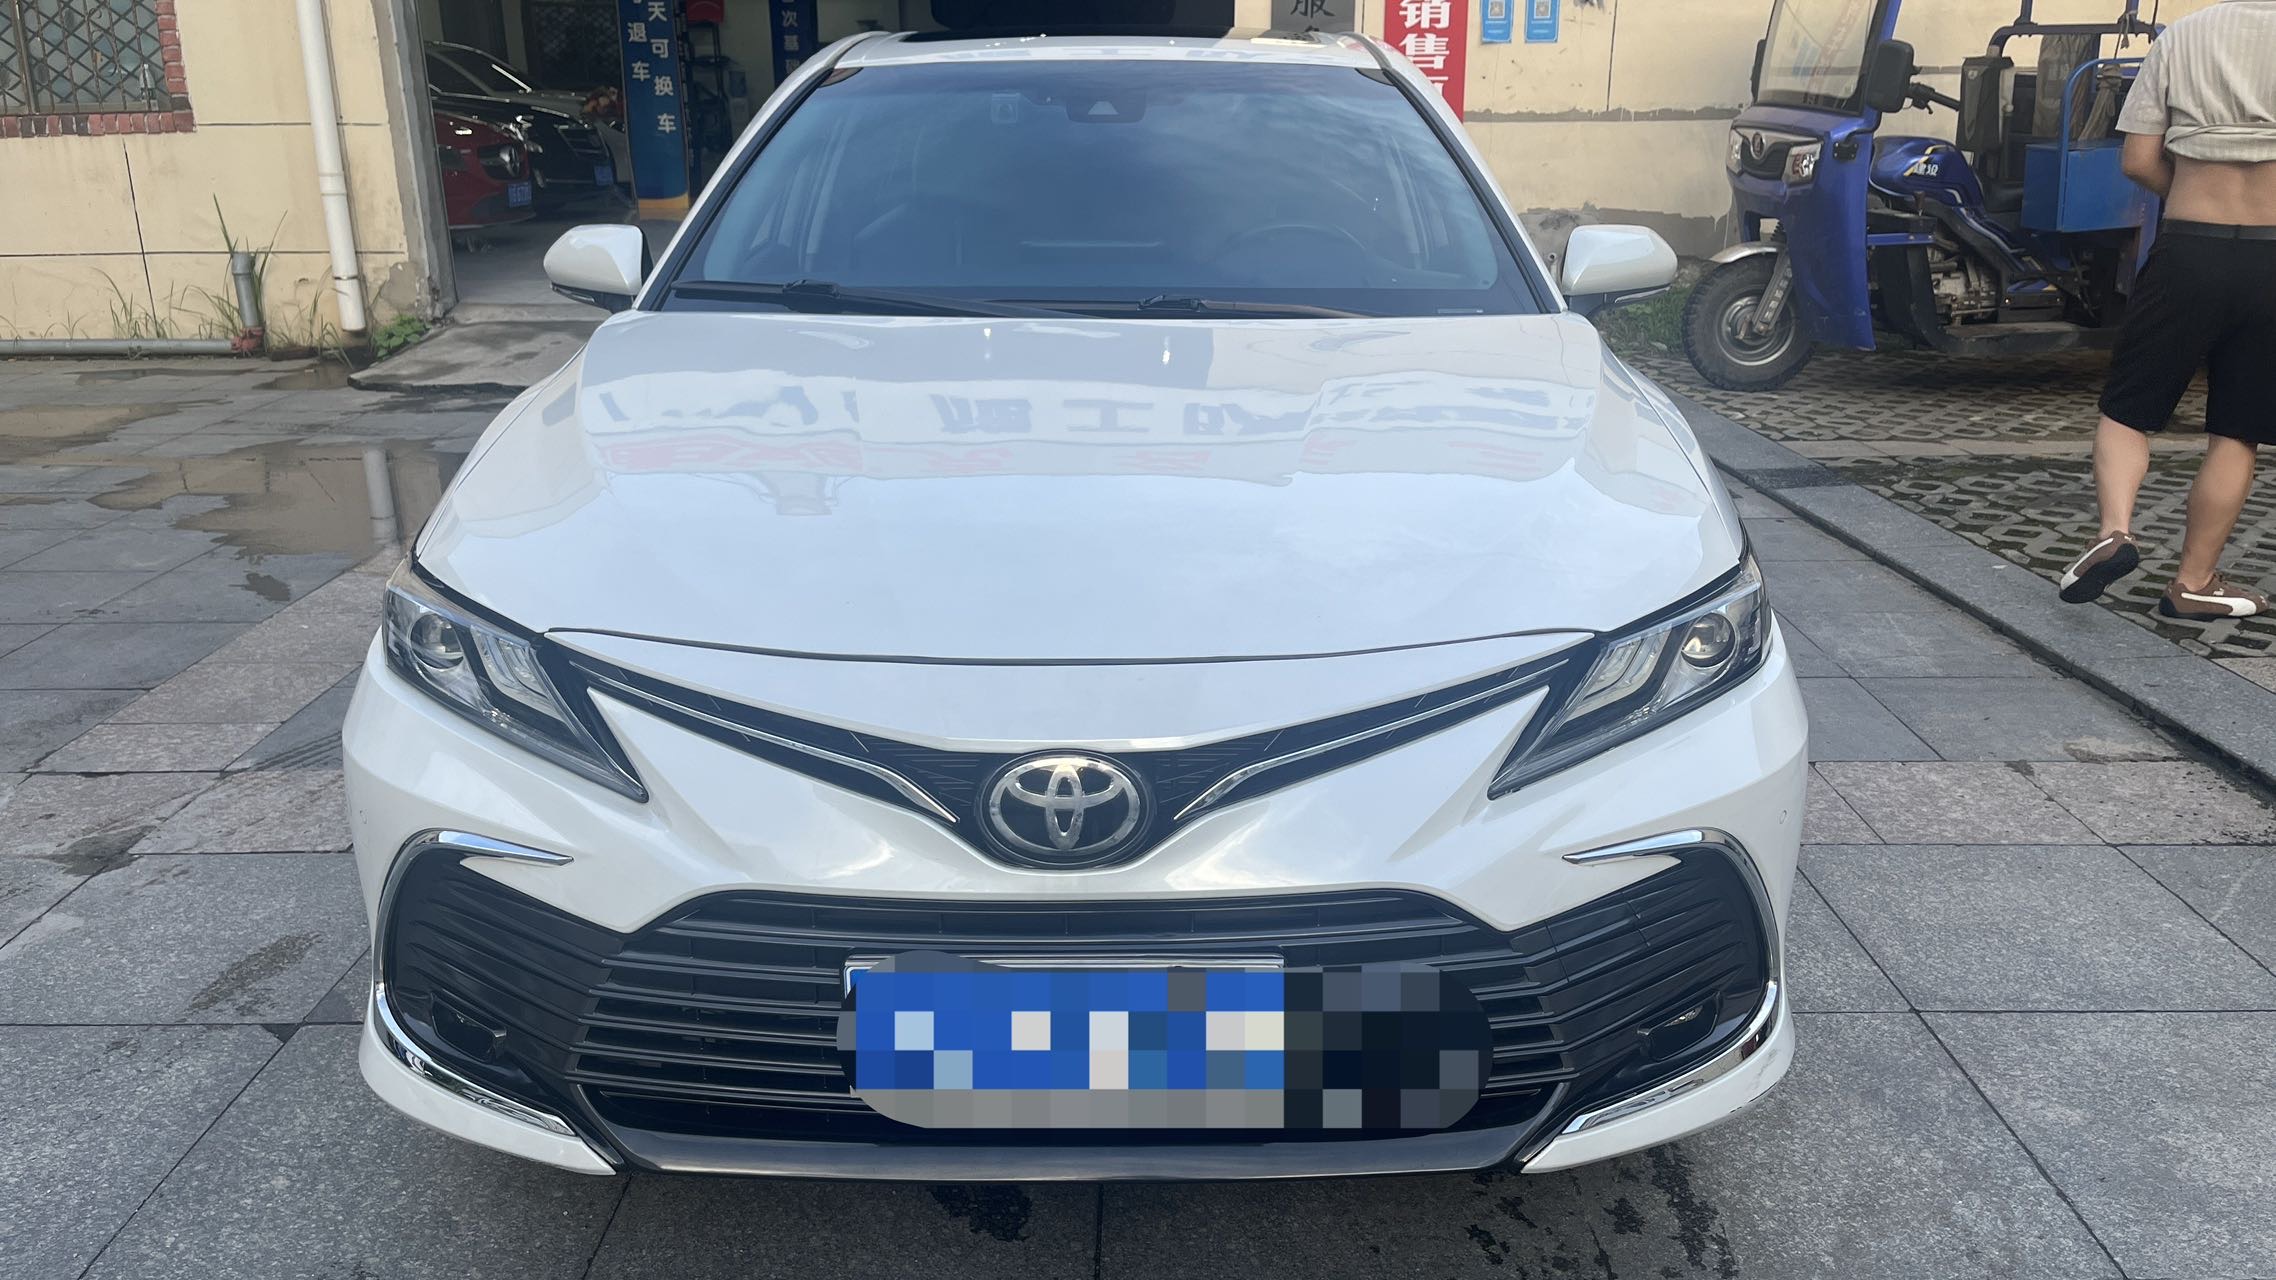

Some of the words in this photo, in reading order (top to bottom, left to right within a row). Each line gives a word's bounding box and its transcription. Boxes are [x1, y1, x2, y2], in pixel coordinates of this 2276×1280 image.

[627, 0, 651, 82] 退车
[647, 1, 677, 133] 天可换车
